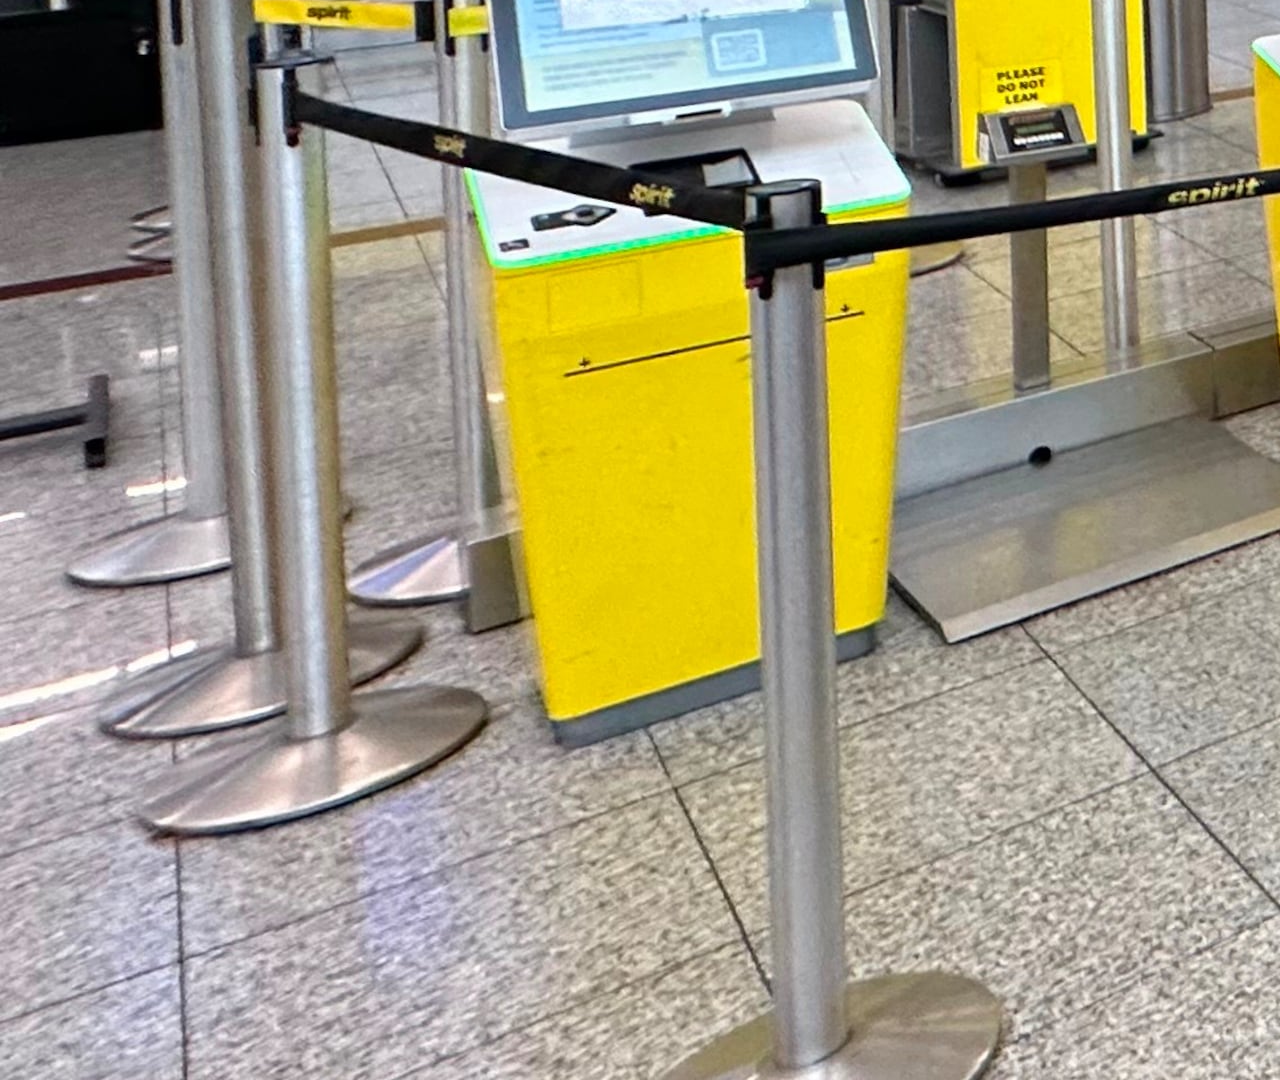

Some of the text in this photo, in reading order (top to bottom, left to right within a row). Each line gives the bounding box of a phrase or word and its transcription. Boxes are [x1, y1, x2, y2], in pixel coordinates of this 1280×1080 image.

[306, 6, 352, 20] spirit
[997, 66, 1046, 81] PLEASE
[997, 78, 1046, 94] DO NOT
[1005, 91, 1039, 105] LEAN
[629, 183, 677, 209] spirit
[1168, 175, 1261, 207] spirit
